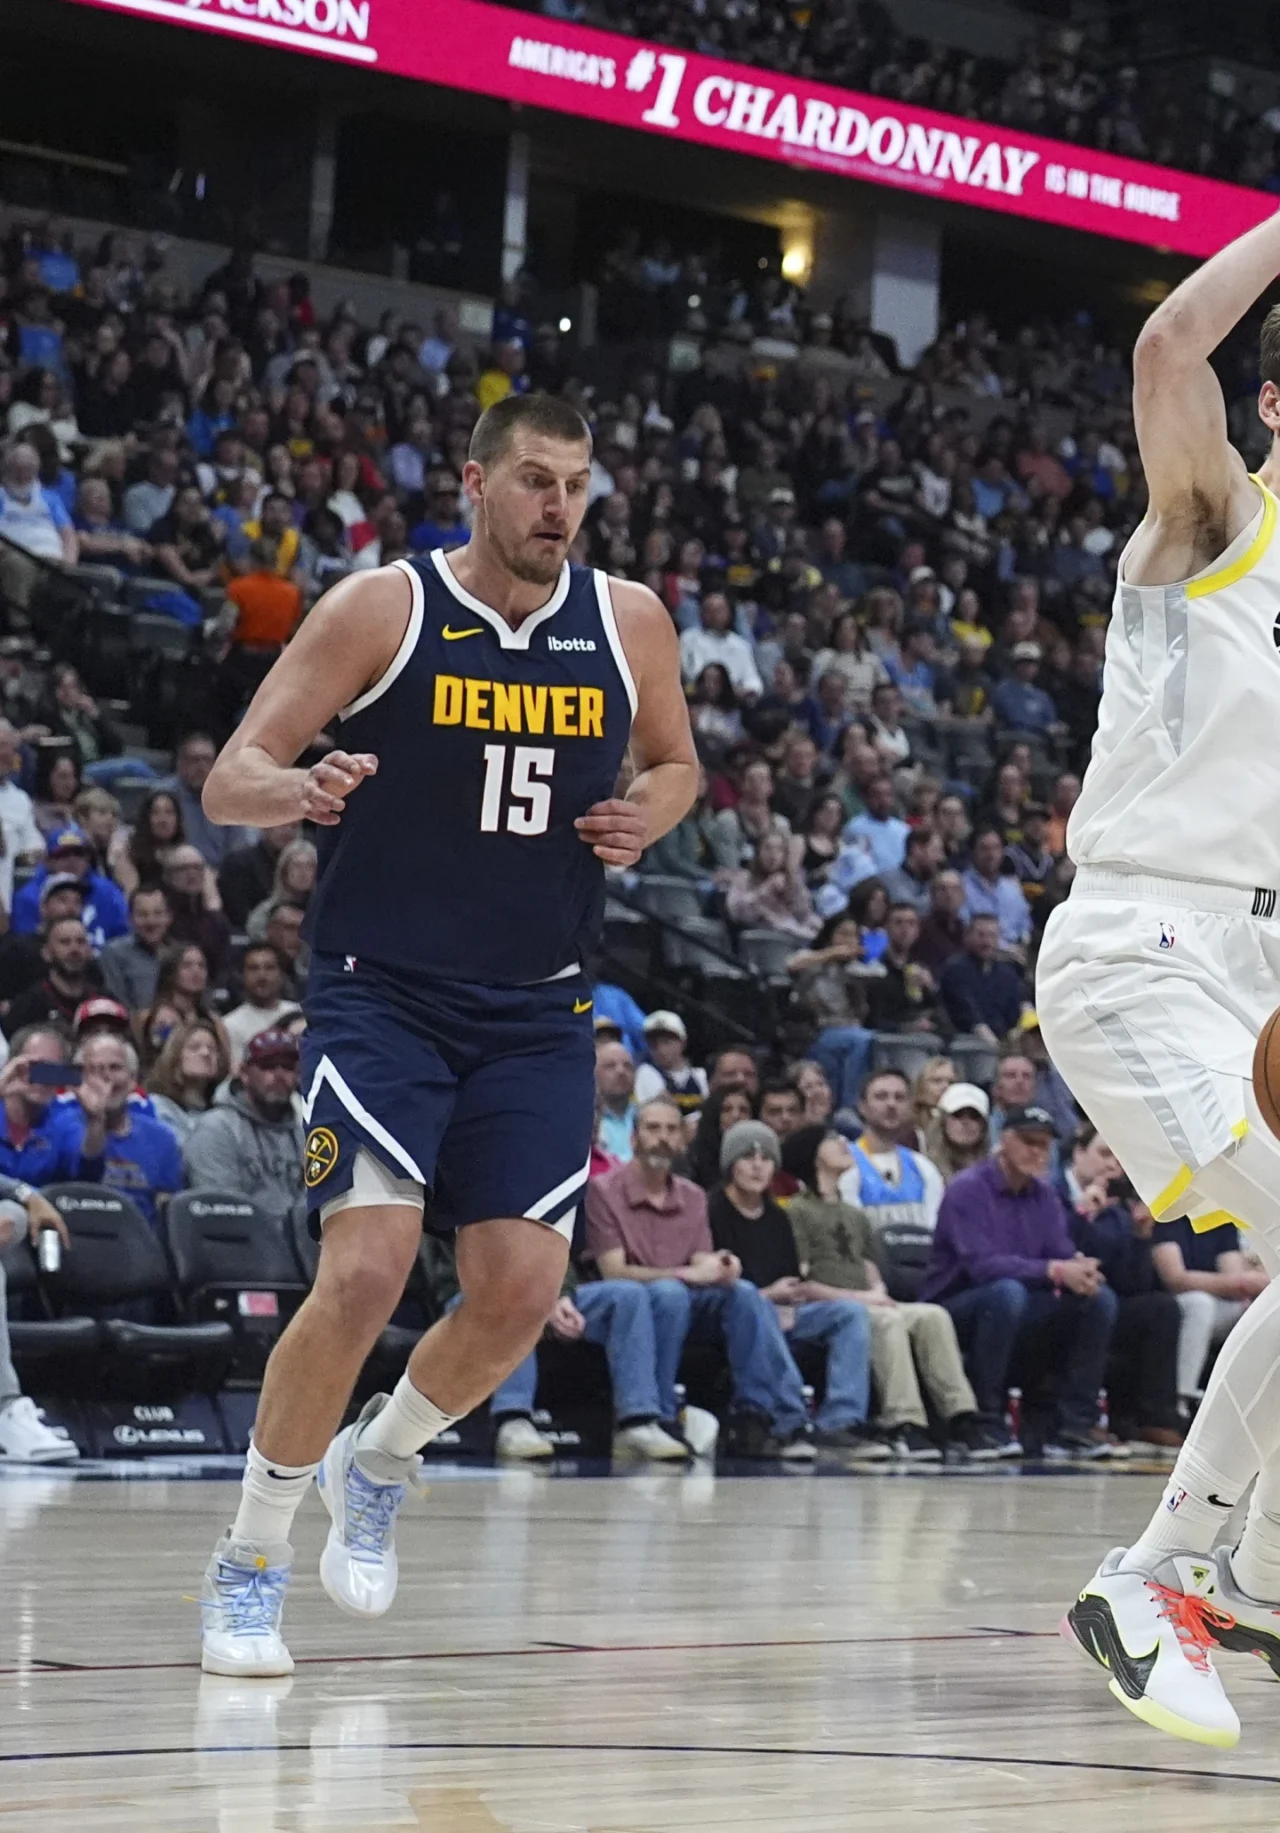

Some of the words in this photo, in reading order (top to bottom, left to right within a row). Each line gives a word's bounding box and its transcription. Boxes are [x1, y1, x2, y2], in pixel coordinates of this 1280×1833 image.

[186, 0, 371, 41] CKSON
[508, 36, 617, 90] AMERICA'S
[625, 48, 687, 129] #1
[693, 75, 1041, 197] CHARDONNAY
[548, 636, 597, 652] ibotta
[432, 674, 604, 738] DENVER
[480, 744, 555, 835] 15
